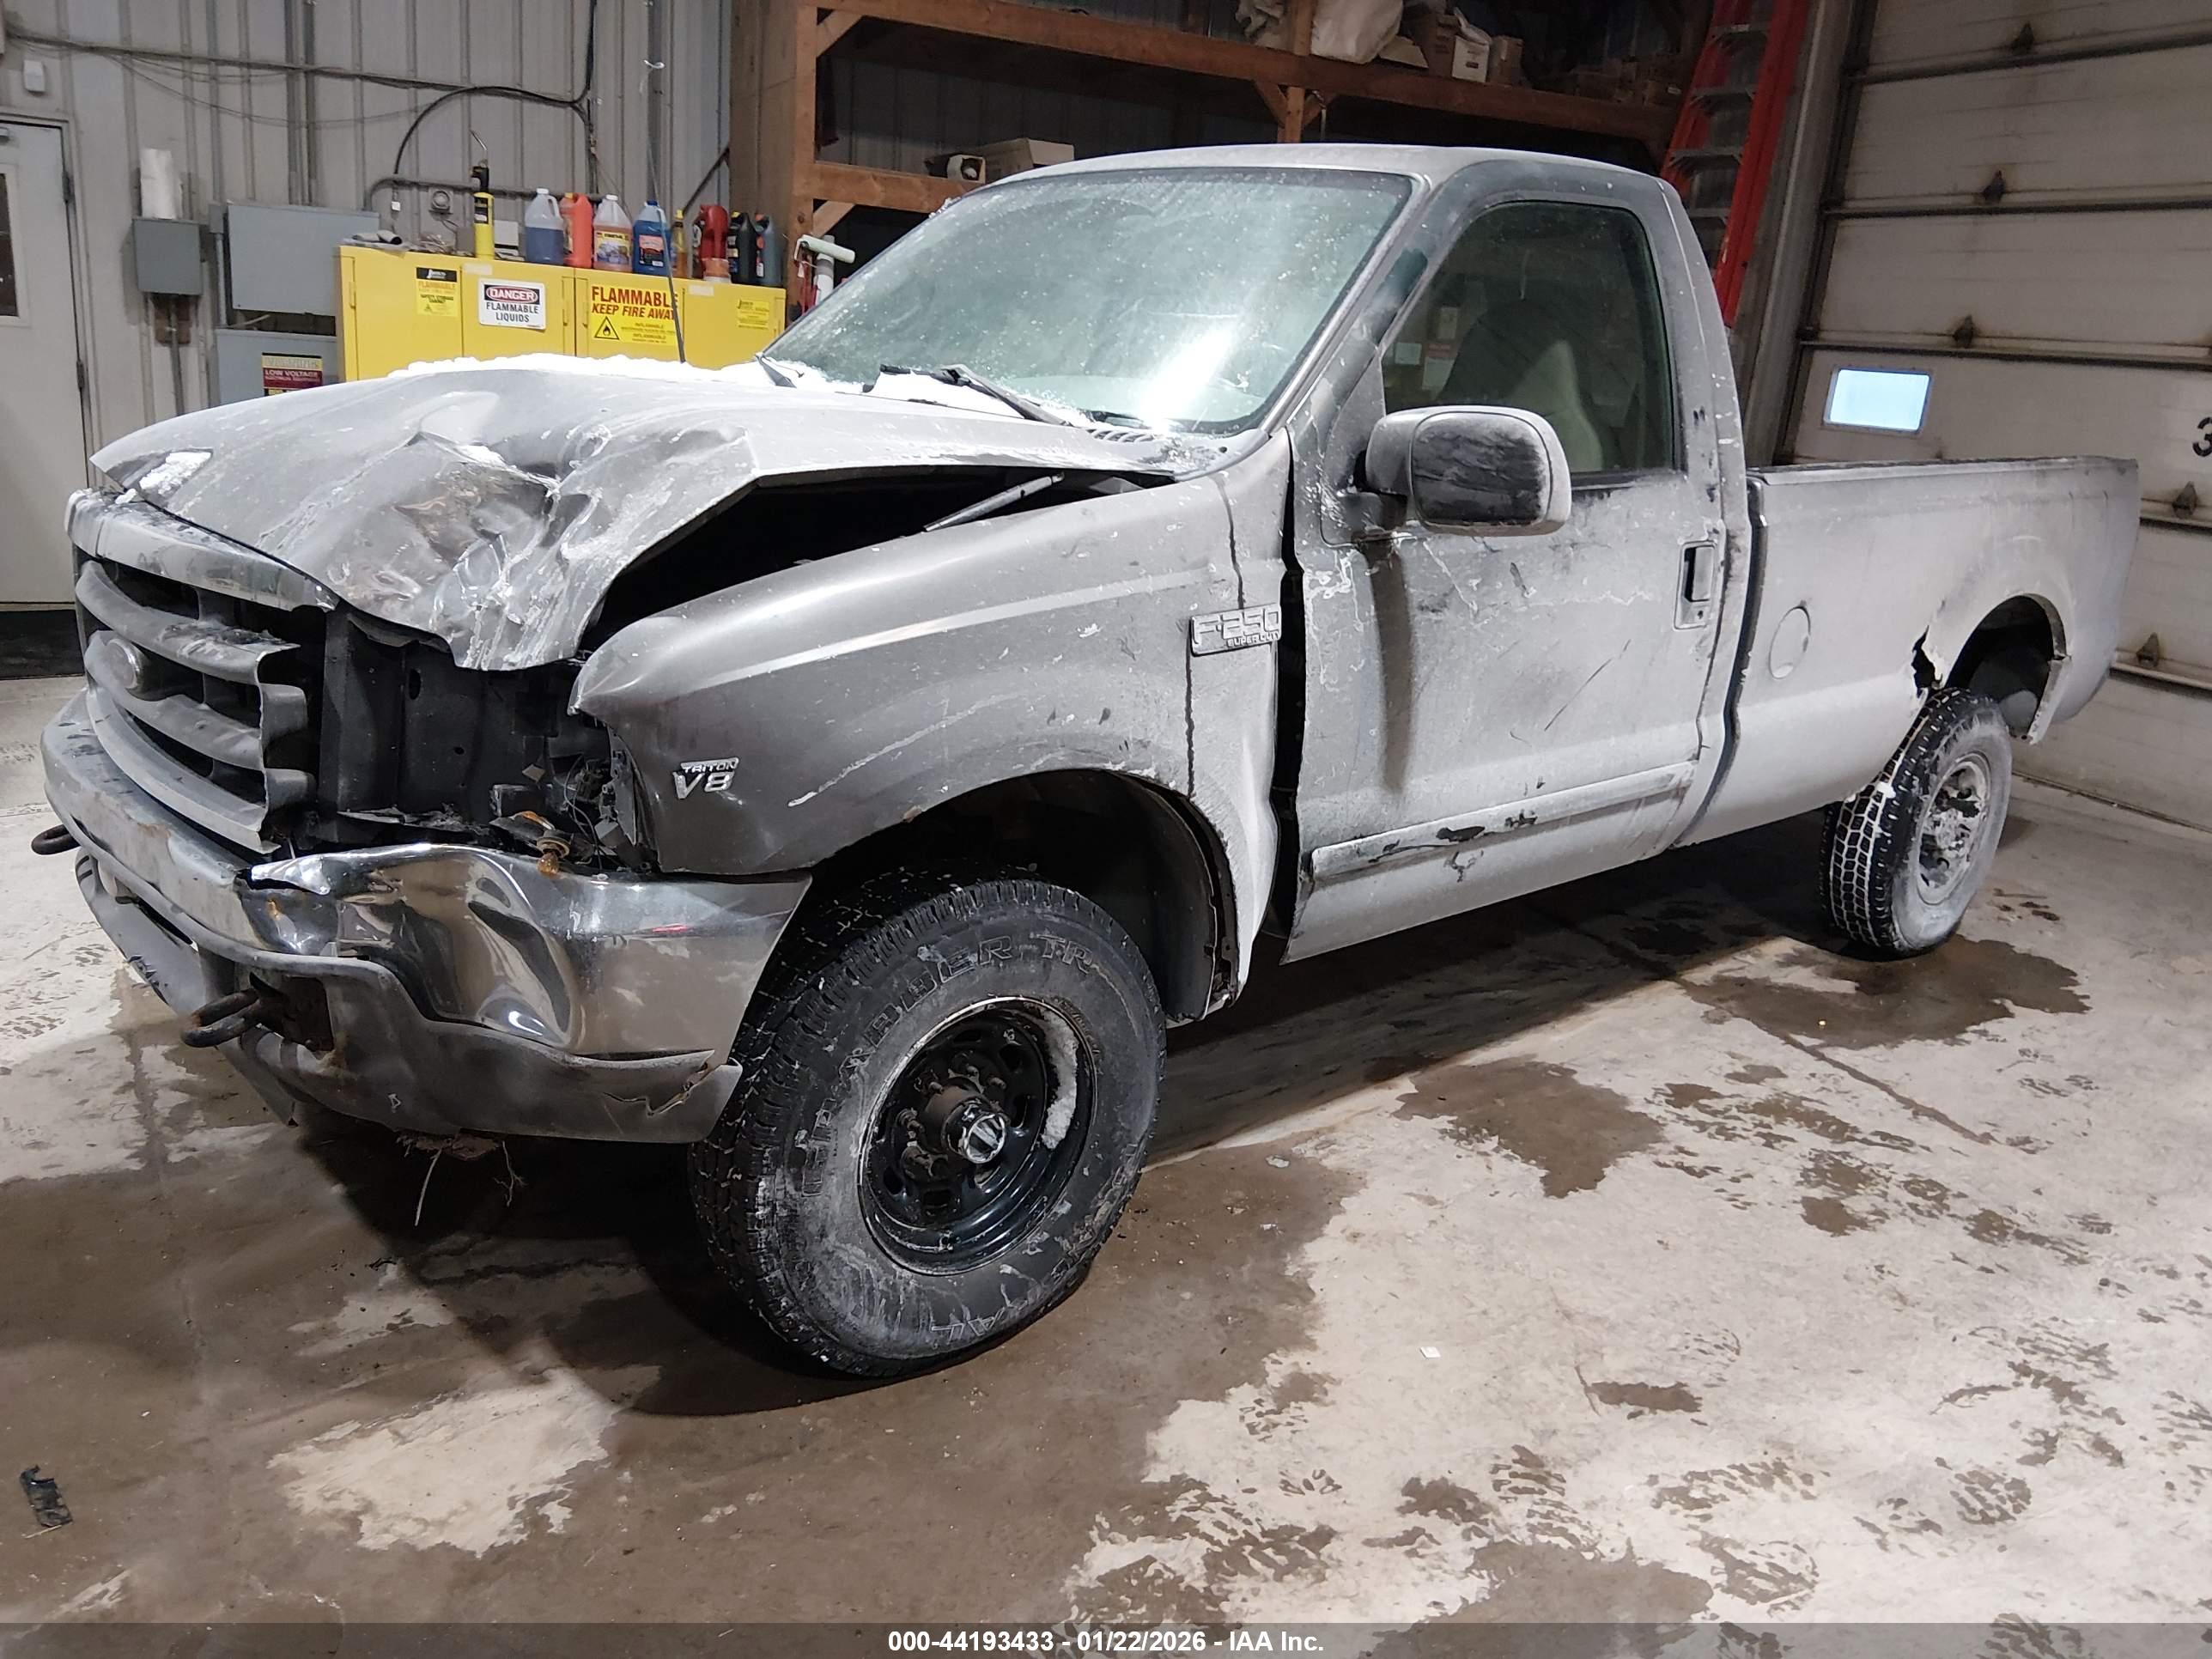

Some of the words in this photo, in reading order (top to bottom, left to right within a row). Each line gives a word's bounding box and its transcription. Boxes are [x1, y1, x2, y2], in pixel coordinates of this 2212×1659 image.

[489, 288, 536, 301] DANGER
[486, 302, 539, 313] FLAMMABLE
[592, 303, 619, 315] KEEP
[623, 306, 646, 318] FIRE
[495, 313, 530, 323] LIQUIDS
[2192, 417, 2212, 457] 3
[683, 759, 738, 773] TRITON
[672, 771, 735, 799] V8
